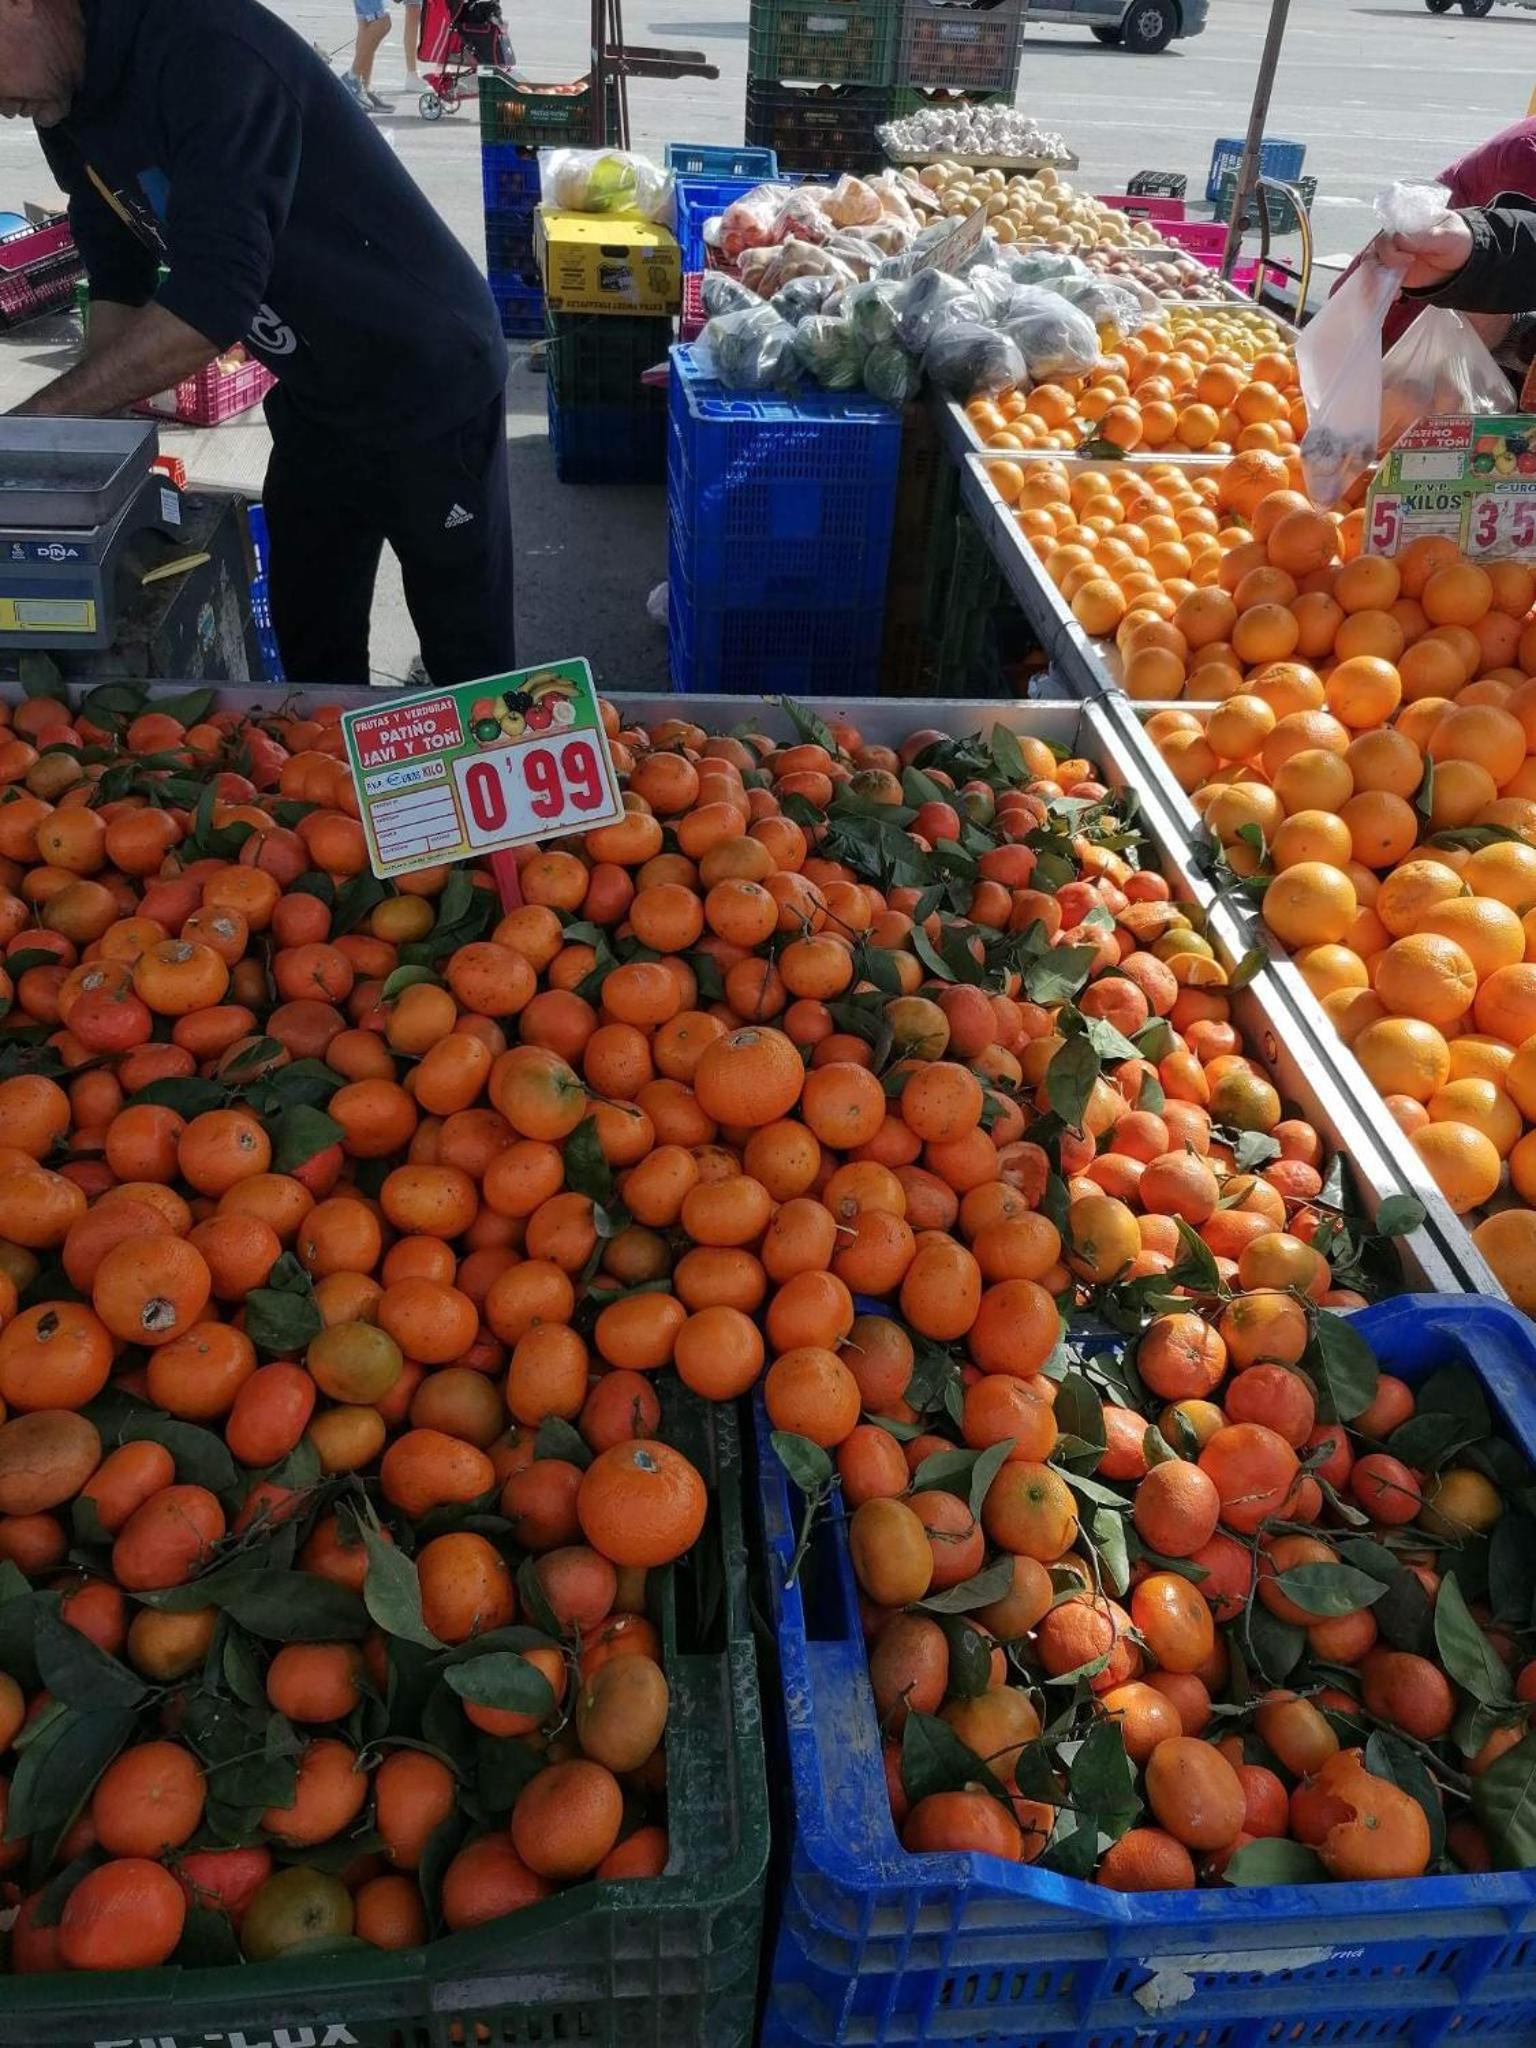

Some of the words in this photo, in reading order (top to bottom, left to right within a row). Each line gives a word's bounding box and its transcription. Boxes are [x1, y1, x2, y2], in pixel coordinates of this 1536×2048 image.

[1406, 494, 1462, 510] KILOS
[1373, 501, 1397, 547] 5
[37, 546, 79, 558] DINA
[356, 716, 390, 732] FRUTAS
[394, 712, 401, 723] Y
[404, 700, 453, 720] VERDURAS
[379, 718, 437, 744] PATIÑO
[363, 749, 396, 766] JAVI
[404, 741, 413, 755] Y
[423, 729, 461, 750] TOÑI
[465, 741, 604, 832] 0'99
